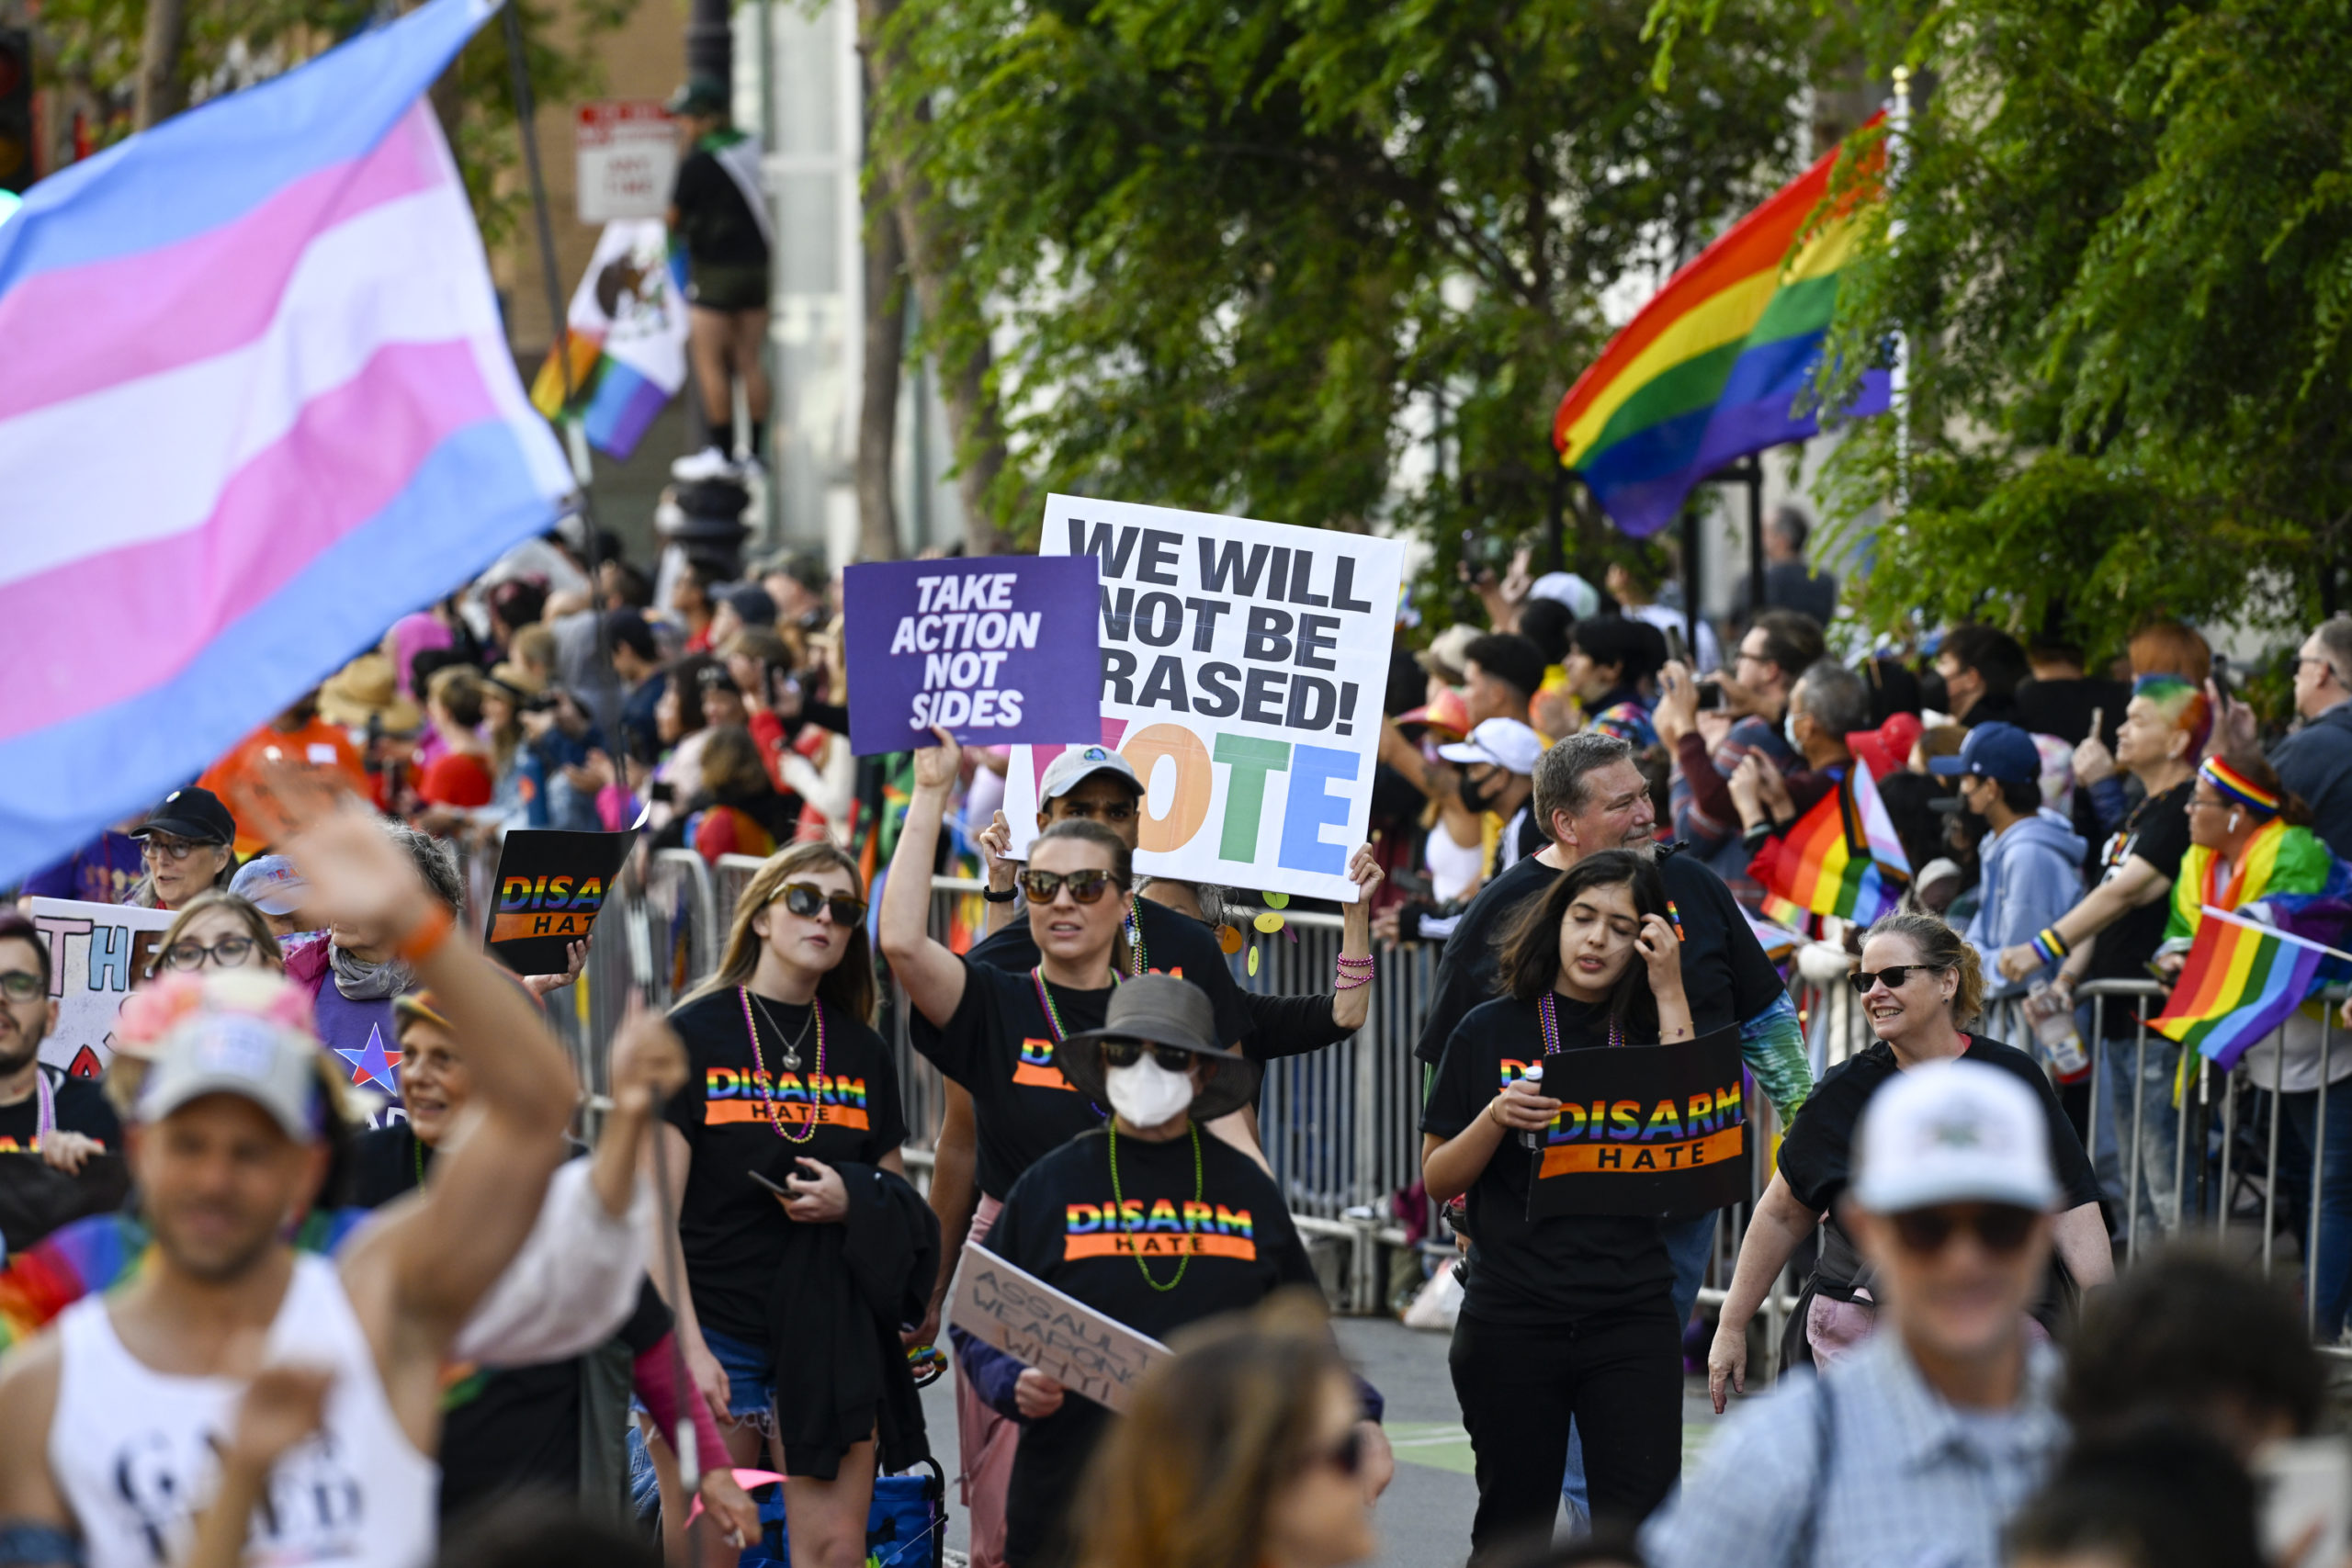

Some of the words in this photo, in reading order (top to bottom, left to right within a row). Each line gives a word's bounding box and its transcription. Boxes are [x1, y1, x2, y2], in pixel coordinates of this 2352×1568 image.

[1068, 518, 1183, 586] WE
[1198, 536, 1372, 614] WILL
[916, 573, 1018, 613] TAKE
[889, 612, 1042, 655] ACTION
[1099, 584, 1231, 653] NOT
[1243, 605, 1341, 671] BE
[923, 651, 1008, 691] NOT
[1099, 647, 1359, 736] RASED!
[909, 689, 1024, 730] SIDES
[499, 873, 616, 911] DISA
[533, 915, 596, 934] HAT
[707, 1066, 866, 1109] DISARM
[752, 1104, 830, 1122] HATE
[1547, 1081, 1741, 1145] DISARM
[1598, 1142, 1704, 1169] HATE
[1067, 1198, 1253, 1239] DISARM
[1115, 1236, 1205, 1254] HATE
[975, 1269, 1148, 1371] ASSAULT
